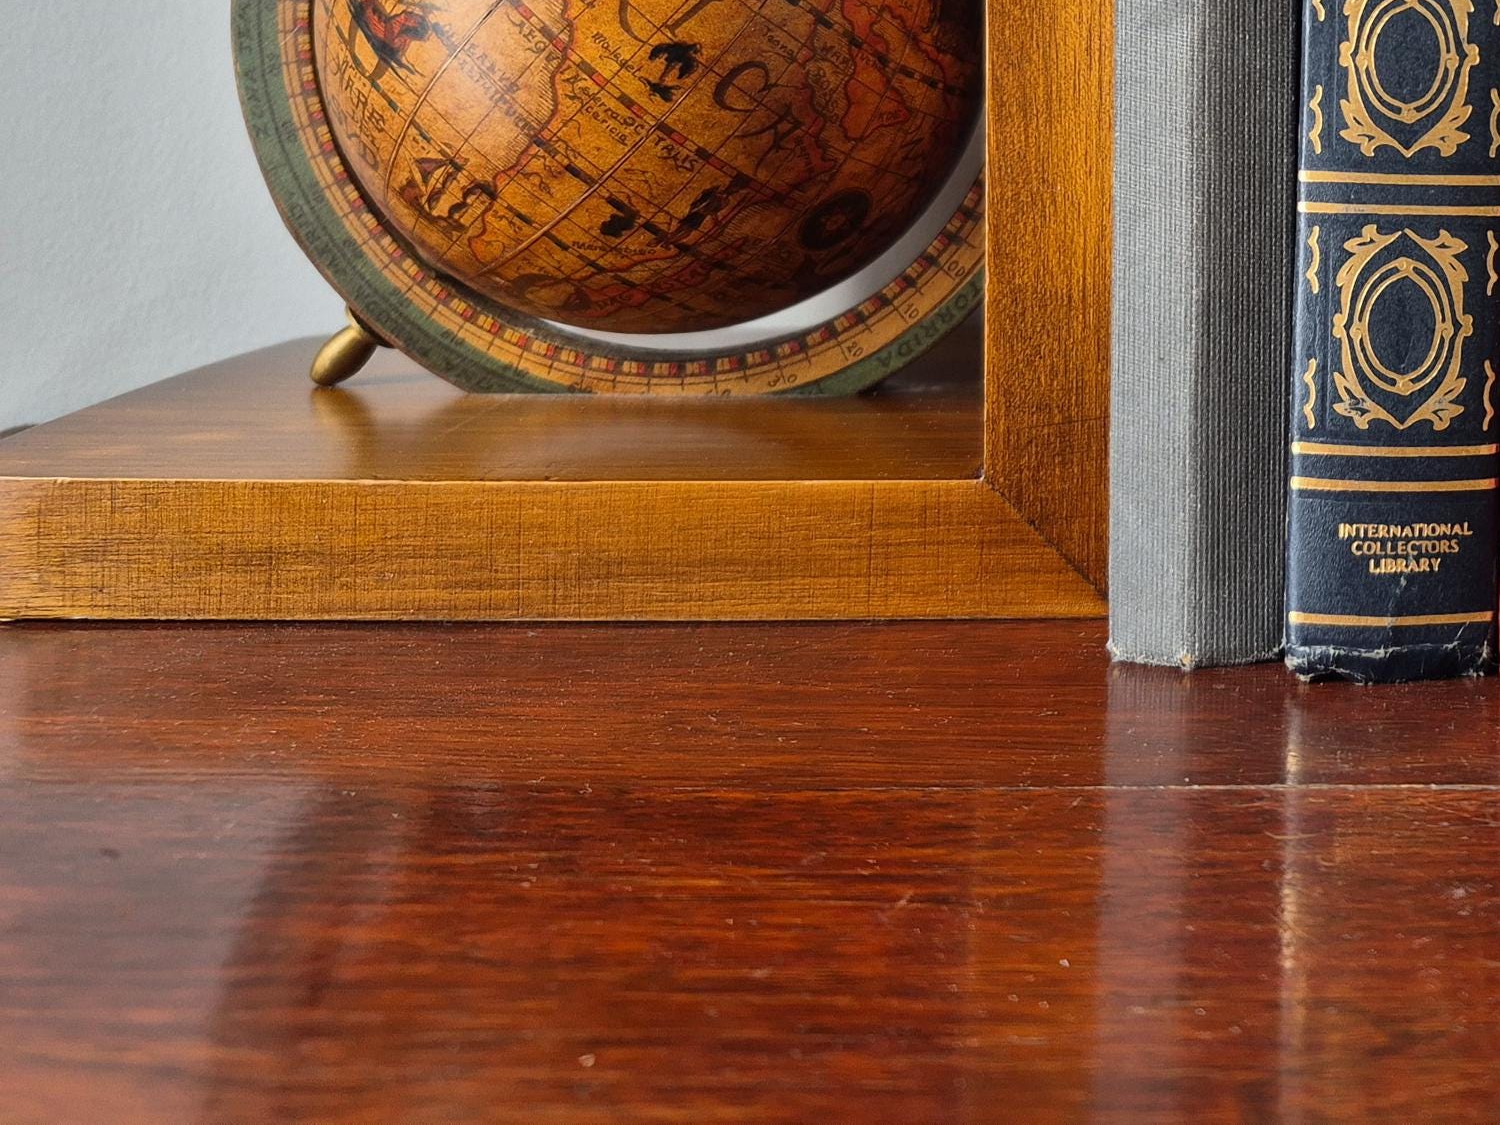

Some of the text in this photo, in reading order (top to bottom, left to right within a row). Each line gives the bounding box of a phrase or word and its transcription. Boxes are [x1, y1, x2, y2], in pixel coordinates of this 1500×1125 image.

[876, 280, 983, 369] TORRIDA
[1337, 522, 1474, 539] INTERNATIONAL
[1350, 539, 1460, 556] COLLECTORS
[1368, 557, 1442, 574] LIBRARY
